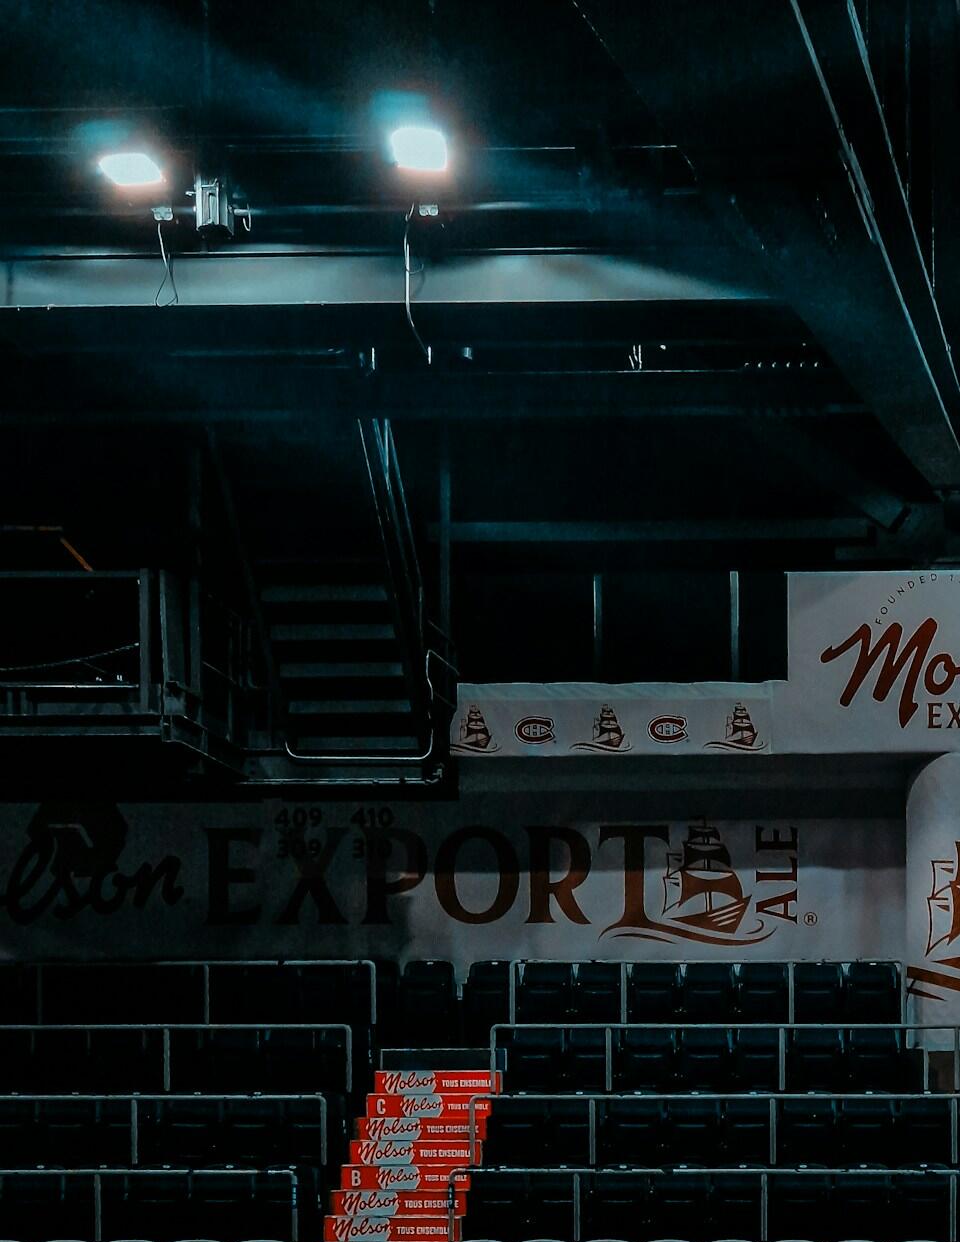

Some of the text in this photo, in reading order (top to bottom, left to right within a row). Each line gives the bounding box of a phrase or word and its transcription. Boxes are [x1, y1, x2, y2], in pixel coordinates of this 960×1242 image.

[875, 573, 938, 625] FOUNDED
[275, 807, 322, 827] 409
[351, 807, 393, 827] 410
[204, 825, 671, 927] EXPORT
[755, 825, 798, 924] ALE
[377, 1099, 385, 1114] C
[352, 1170, 361, 1186] B
